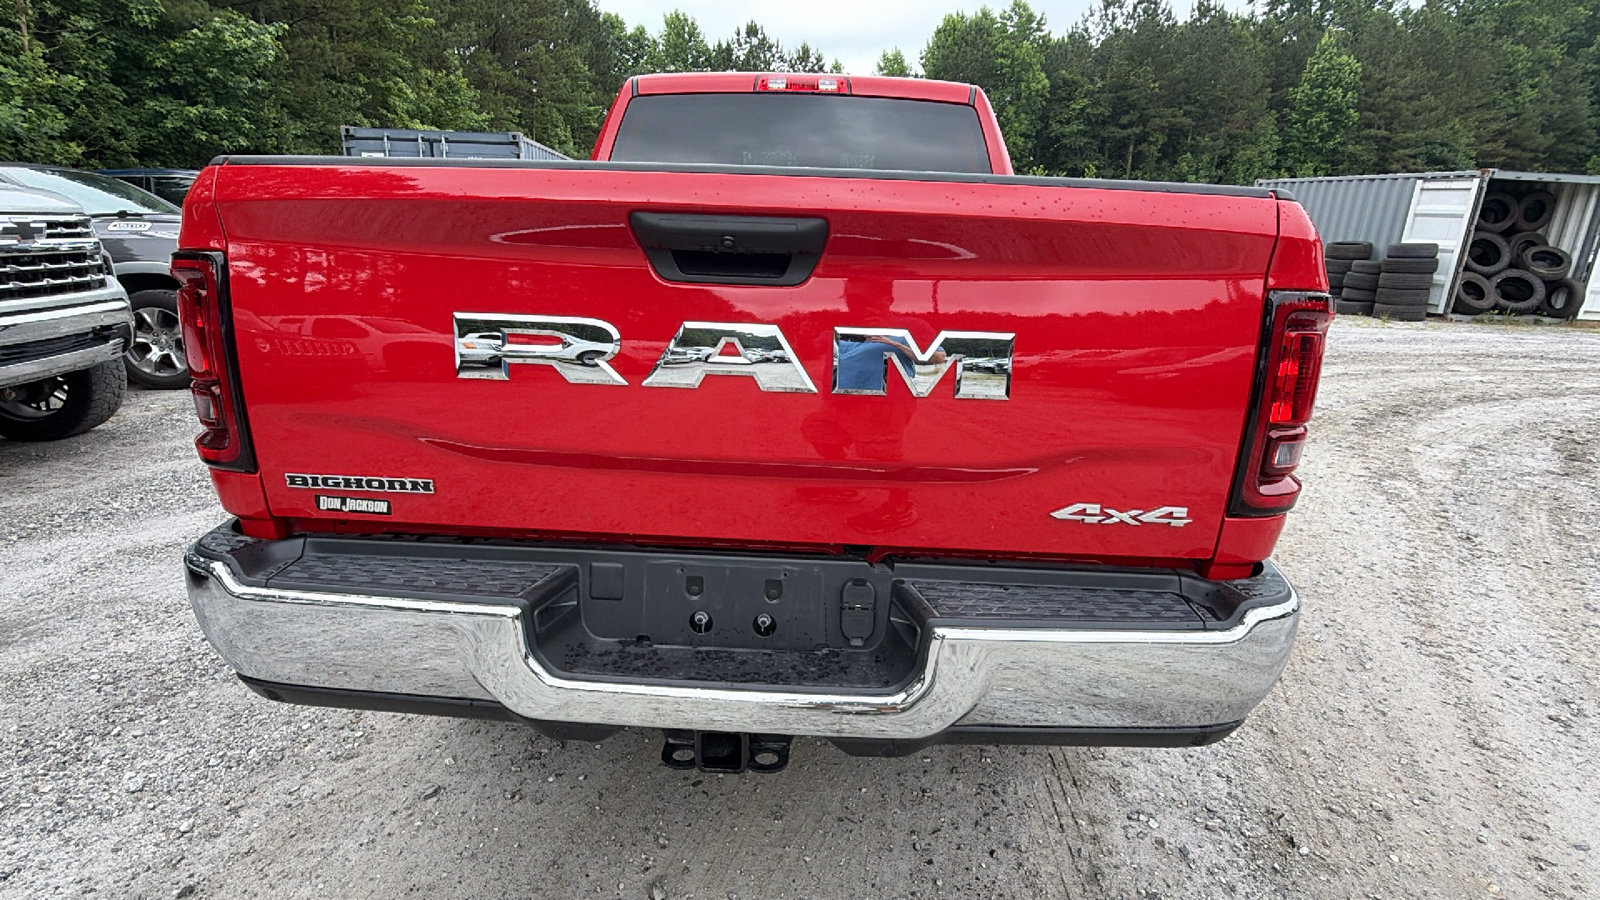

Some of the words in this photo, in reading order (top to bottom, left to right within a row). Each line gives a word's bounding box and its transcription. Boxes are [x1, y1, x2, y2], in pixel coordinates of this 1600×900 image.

[453, 311, 1016, 400] RAM
[285, 473, 435, 494] BIGHORN
[319, 496, 342, 511] DON
[341, 497, 389, 513] JACKSON
[1050, 503, 1193, 527] 4x4
